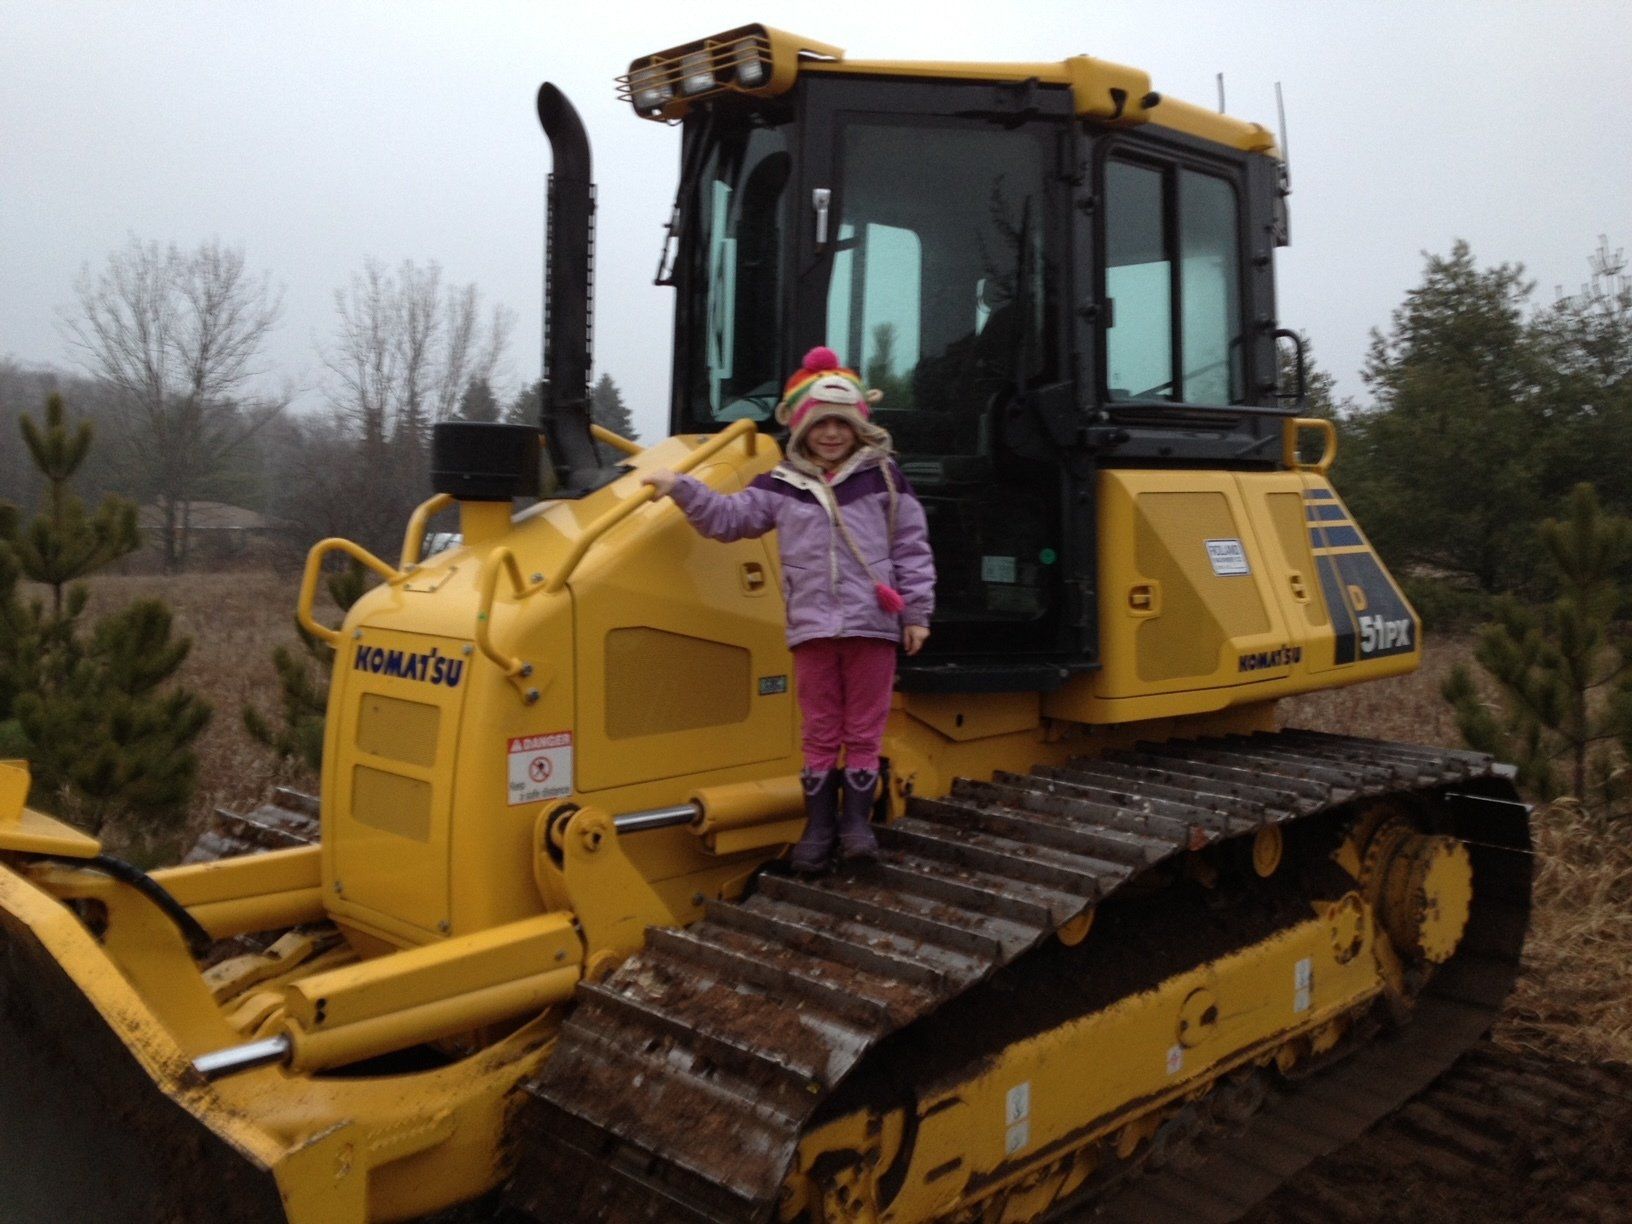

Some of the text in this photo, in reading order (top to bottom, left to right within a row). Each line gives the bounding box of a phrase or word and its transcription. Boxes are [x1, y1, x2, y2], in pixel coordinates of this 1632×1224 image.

[1347, 585, 1368, 611] D
[1358, 615, 1411, 652] 51PX
[354, 645, 463, 687] KOMATSU
[1239, 645, 1302, 672] KOMATSU
[523, 733, 571, 751] DANGER
